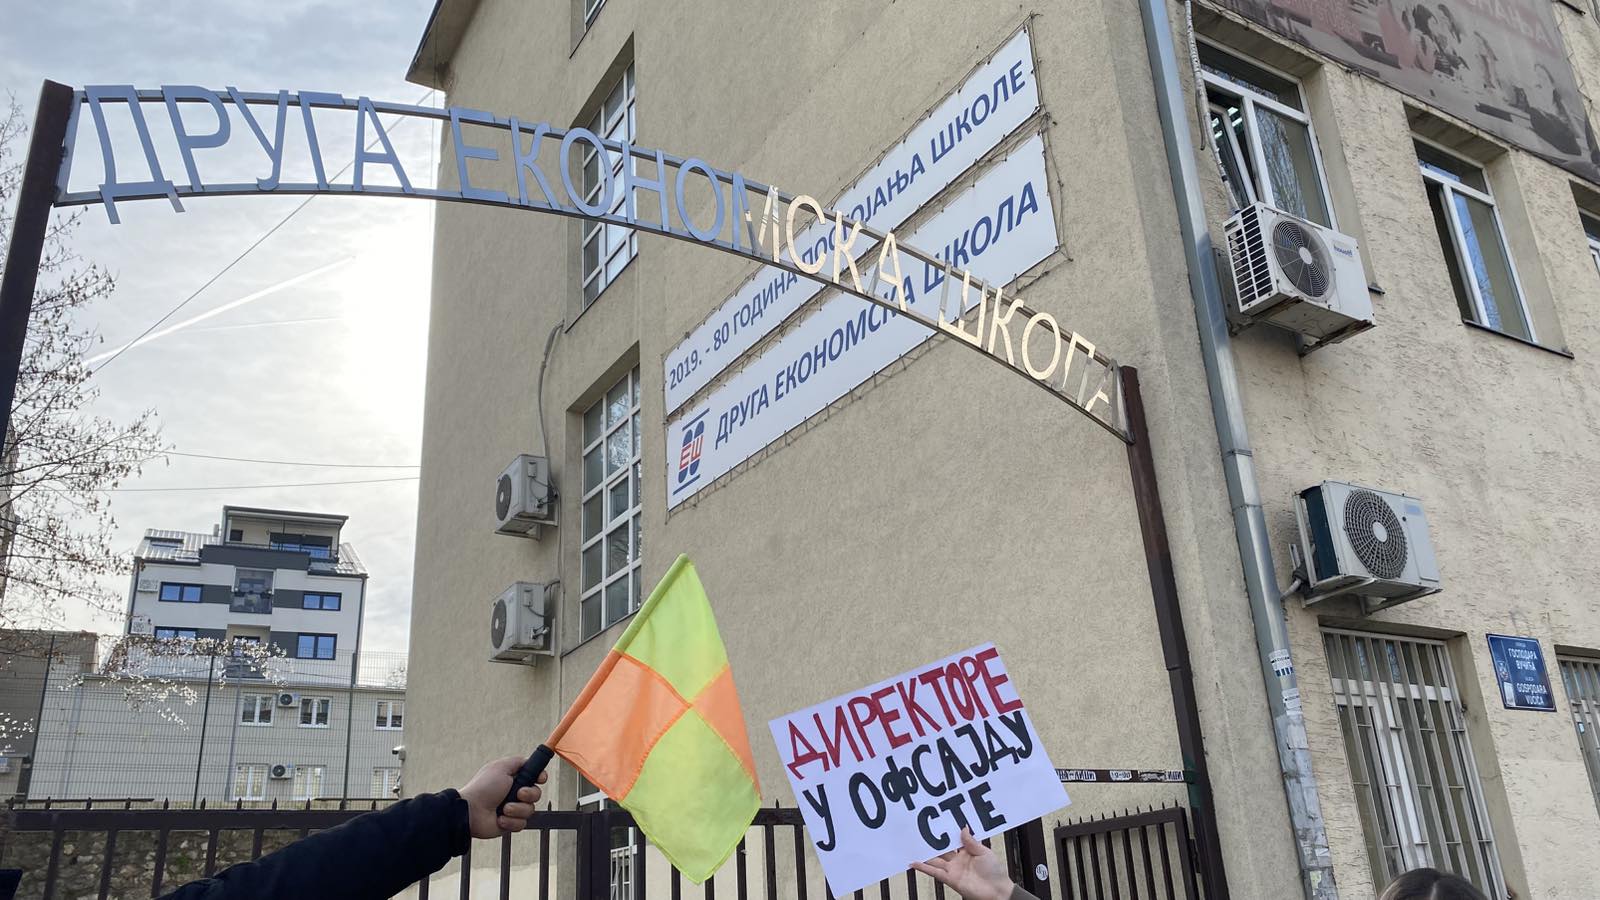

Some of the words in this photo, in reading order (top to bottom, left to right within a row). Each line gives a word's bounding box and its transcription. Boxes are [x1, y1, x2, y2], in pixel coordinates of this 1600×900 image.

[84, 84, 416, 225] ДРУГА
[450, 106, 908, 312] ЕКОНОМСКА
[669, 350, 702, 390] 2019.
[713, 322, 729, 351] 80
[733, 269, 798, 335] ГОДИНА
[931, 60, 1026, 165] ШКОЛЕ
[715, 384, 770, 450] ДРУГА
[775, 275, 916, 401] ЕКОНОМСКА
[924, 181, 1038, 294] ШКОЛА
[787, 647, 1024, 779] ДИРЕКТОРЕ
[802, 783, 836, 851] У
[917, 781, 1007, 850] СТЕ
